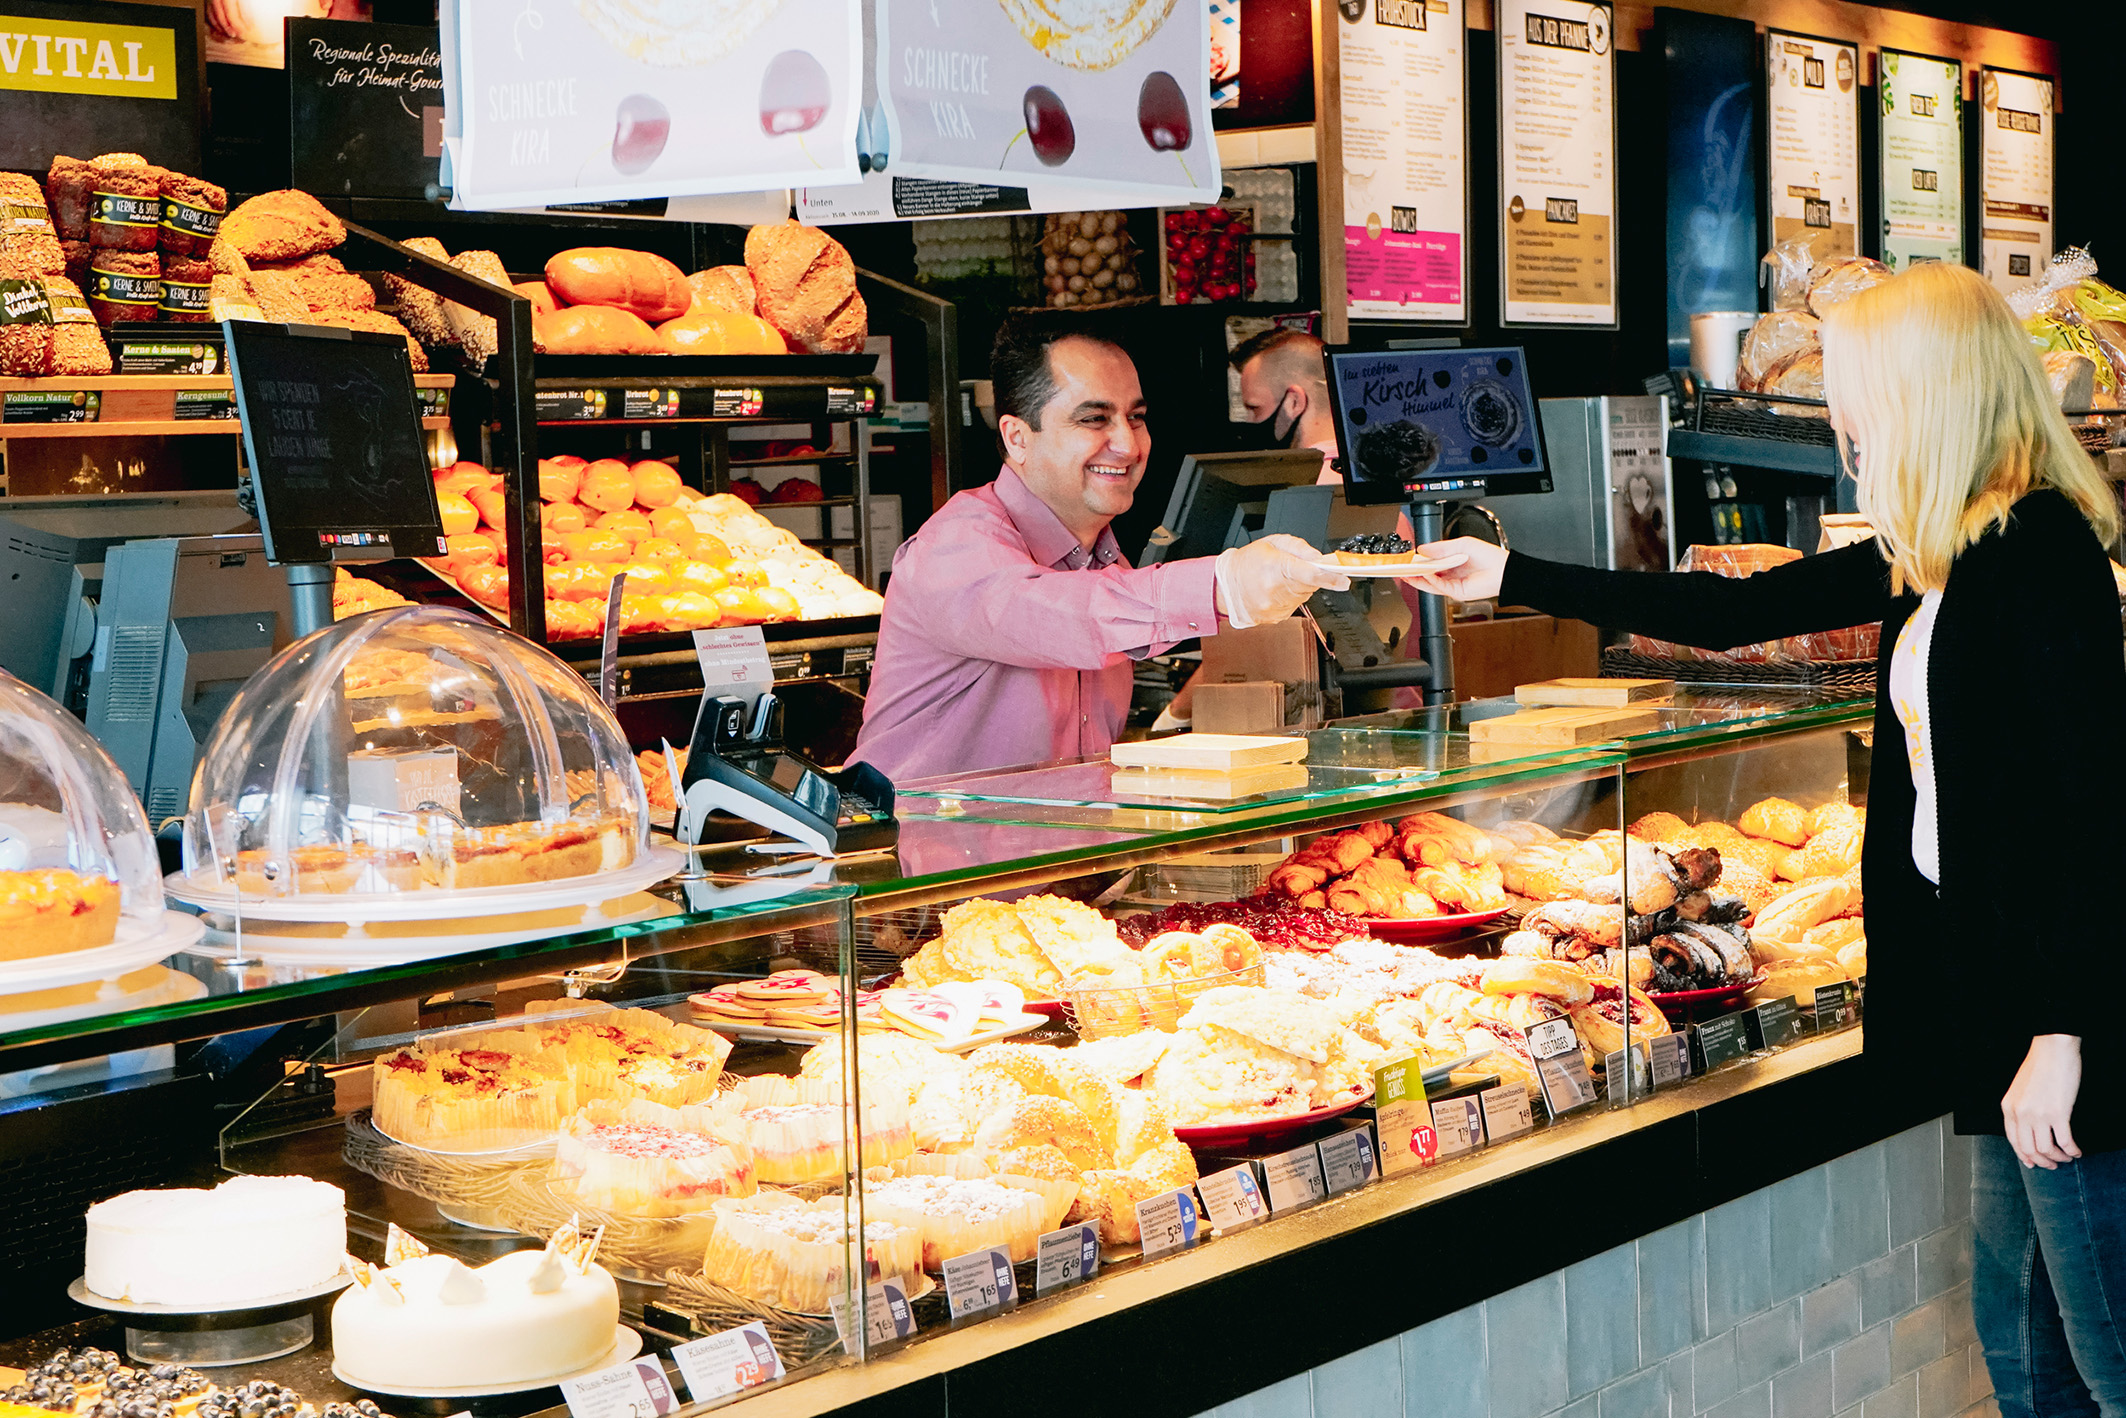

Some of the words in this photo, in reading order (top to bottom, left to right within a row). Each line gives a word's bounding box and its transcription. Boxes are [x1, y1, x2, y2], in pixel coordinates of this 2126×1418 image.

[1528, 16, 1543, 42] AUS
[1543, 18, 1559, 44] DER
[1560, 20, 1589, 49] PFANNE
[0, 32, 154, 82] VITAL
[308, 38, 374, 65] Regionale
[327, 67, 355, 87] für
[904, 47, 989, 95] SCHNECKE
[1805, 61, 1824, 86] MILD
[489, 78, 577, 122] SCHNECKE
[930, 100, 976, 140] KIRA
[510, 128, 549, 166] KIRA
[116, 200, 135, 212] KERNE
[139, 202, 144, 212] &
[810, 199, 834, 207] Unten
[181, 208, 202, 222] KERNE
[202, 215, 208, 226] &
[113, 278, 134, 292] KERNE
[135, 280, 141, 292] &
[170, 288, 190, 300] KERNE
[192, 290, 197, 300] &
[3, 284, 38, 305] Dinkel
[4, 300, 49, 318] Vollkorn
[123, 345, 150, 354] Kerne
[152, 345, 159, 354] &
[161, 345, 190, 354] Saaten
[1363, 367, 1428, 406] Kirsch
[6, 394, 44, 402] Vollkorn
[46, 393, 72, 401] Natur
[177, 391, 228, 401] Kerngesund
[1401, 393, 1455, 416] Himmel
[1543, 1024, 1556, 1039] TIPP
[1540, 1041, 1553, 1055] DES
[1551, 1036, 1569, 1053] TAGES
[1360, 1145, 1371, 1156] OHNE
[1414, 1129, 1430, 1155] 1,77
[1362, 1154, 1372, 1164] HEFE
[1140, 1199, 1177, 1217] Kranzkuchen
[1233, 1198, 1247, 1216] 1,95
[1167, 1223, 1181, 1243] 5,29
[1083, 1241, 1094, 1251] OHNE
[1083, 1250, 1094, 1260] HEFE
[996, 1266, 1009, 1278] OHNE
[1062, 1257, 1080, 1278] 6,49
[997, 1275, 1010, 1287] HEFE
[980, 1284, 996, 1305] 1,65
[891, 1299, 905, 1311] OHNE
[894, 1309, 908, 1320] HEFE
[686, 1338, 735, 1359] Käsesahne
[752, 1342, 770, 1354] OHNE
[757, 1353, 774, 1365] HEFE
[575, 1370, 634, 1394] Nuss-Sahne
[736, 1362, 759, 1386] 2,29
